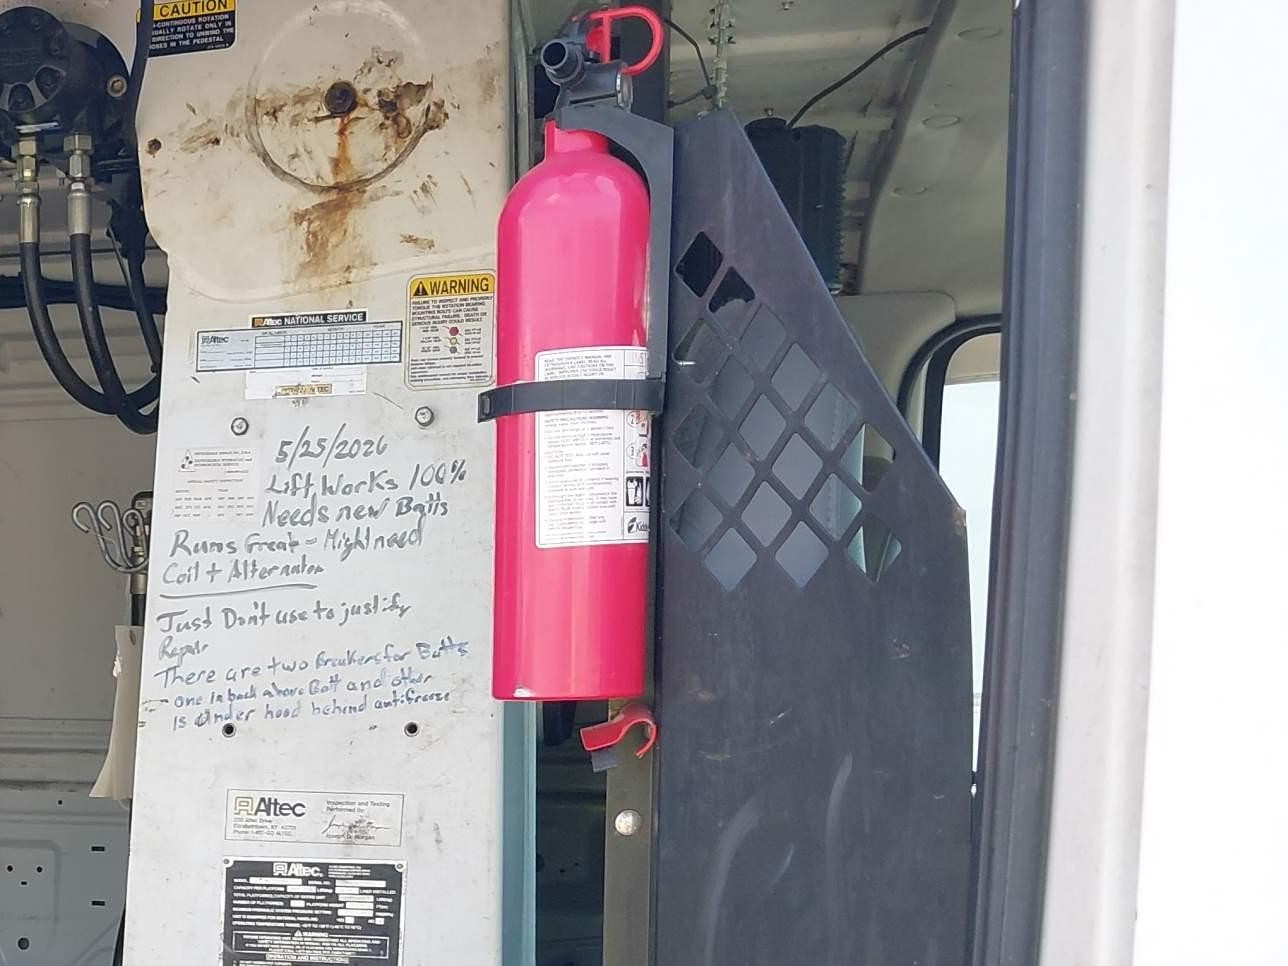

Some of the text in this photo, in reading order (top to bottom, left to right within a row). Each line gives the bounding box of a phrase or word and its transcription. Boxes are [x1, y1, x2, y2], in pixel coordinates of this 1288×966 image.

[159, 0, 228, 18] CAUTION
[177, 25, 202, 33] ROTATE
[193, 36, 224, 44] PEDESTAL
[429, 277, 489, 295] WARNING
[284, 315, 326, 325] NATIONAL
[326, 312, 364, 323] SERVICE
[274, 423, 388, 470] 5/25/2026
[265, 472, 314, 499] Lift
[321, 469, 399, 496] Works
[262, 492, 329, 528] Needs
[336, 497, 390, 522] new
[206, 562, 222, 583] +
[313, 599, 335, 620] to
[153, 664, 216, 688] There
[225, 666, 261, 682] are
[267, 656, 309, 676] two
[254, 796, 306, 818] Altec
